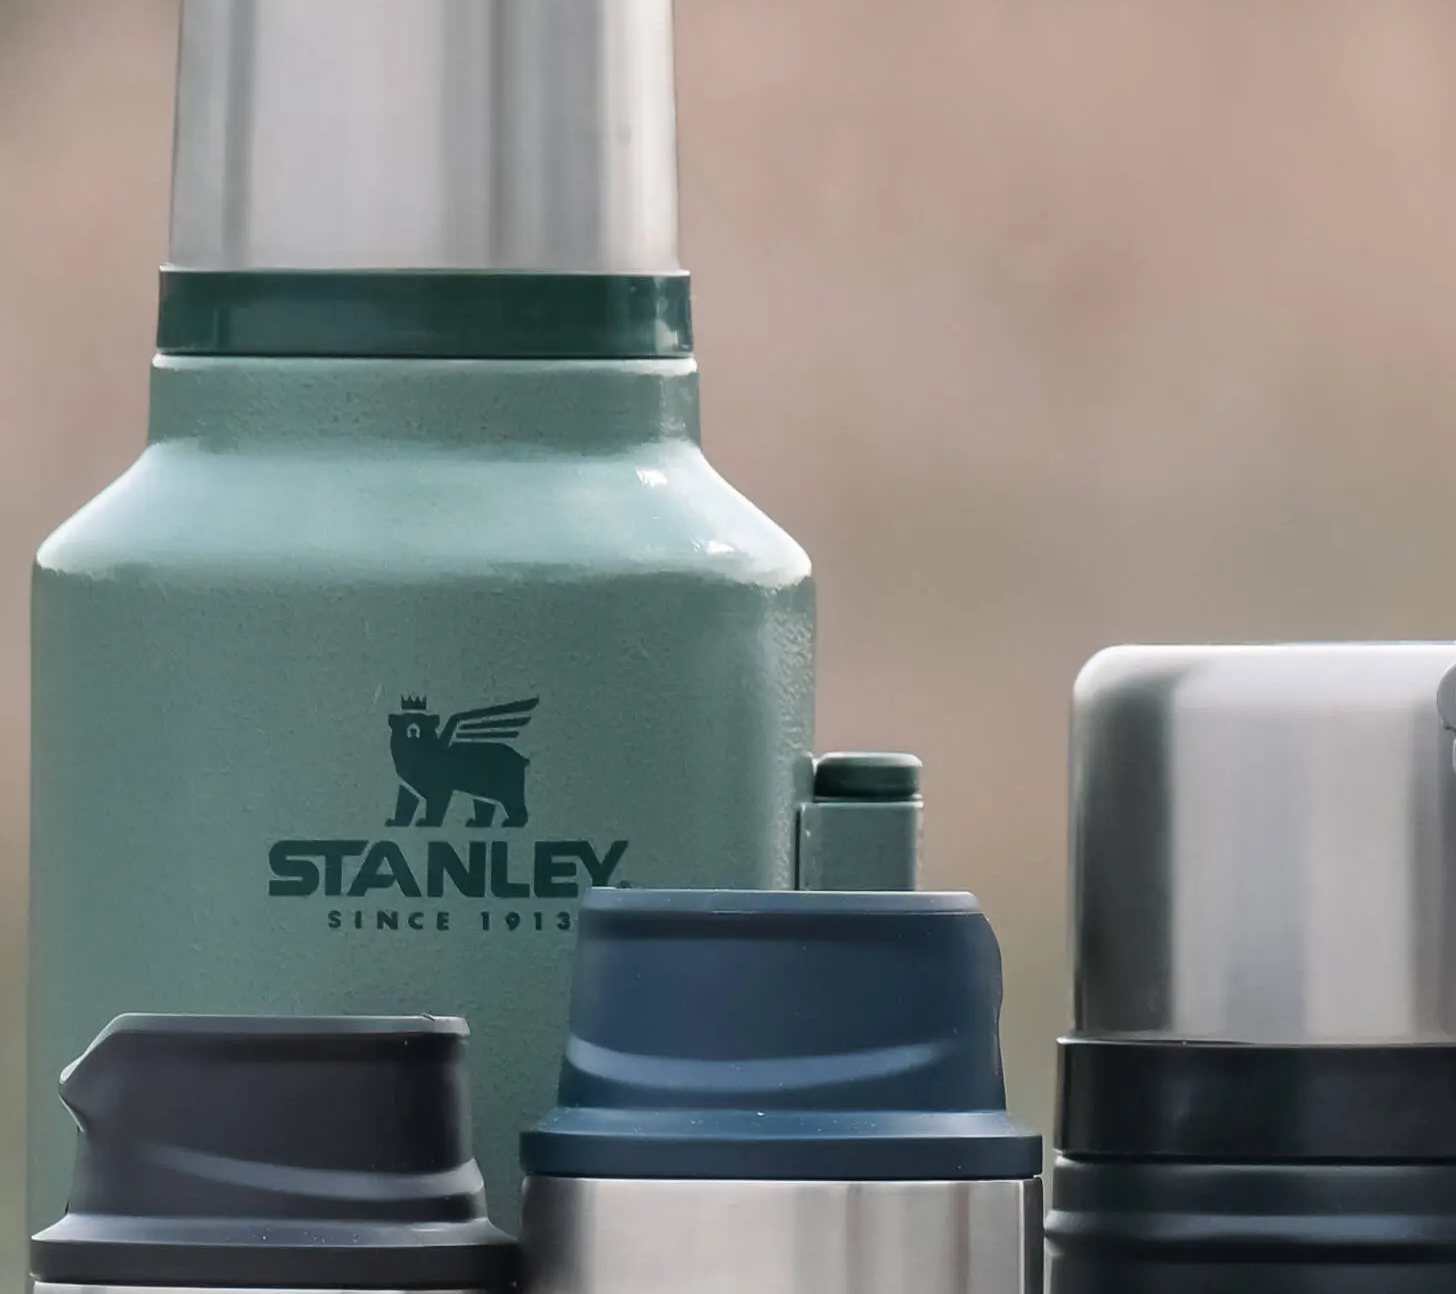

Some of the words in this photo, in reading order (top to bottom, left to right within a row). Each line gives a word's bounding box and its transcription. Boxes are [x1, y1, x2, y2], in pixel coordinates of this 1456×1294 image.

[269, 839, 629, 898] STANLEY
[328, 910, 450, 932] SINCE
[481, 910, 573, 932] 1913
